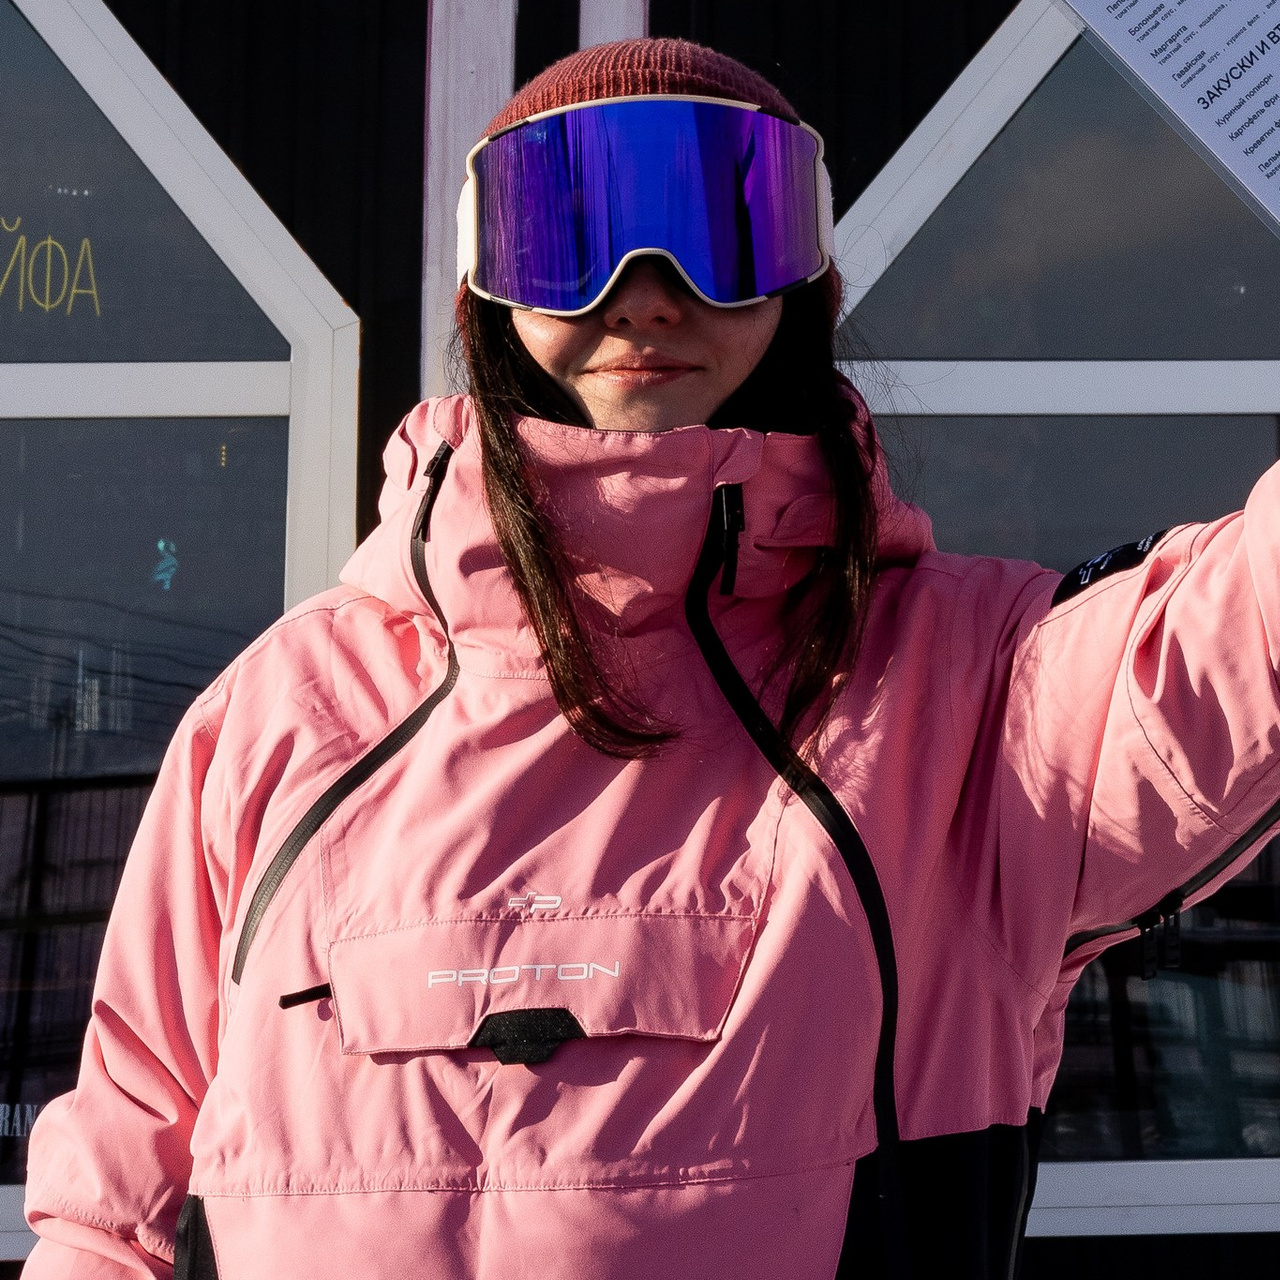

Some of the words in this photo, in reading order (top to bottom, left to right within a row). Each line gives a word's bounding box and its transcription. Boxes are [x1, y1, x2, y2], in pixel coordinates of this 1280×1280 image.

[1127, 2, 1165, 37] Болоньезе
[1149, 25, 1188, 59] Маргарита
[1171, 50, 1206, 82] Гавайская
[1196, 50, 1260, 110] ЗАКУСКИ
[1254, 39, 1271, 56] И
[1214, 97, 1247, 128] Куриный
[1244, 73, 1274, 101] попкорн
[1228, 108, 1266, 142] Картофель
[1263, 93, 1280, 108] Фри
[1242, 126, 1276, 157] Креветки
[427, 960, 621, 989] PROTON
